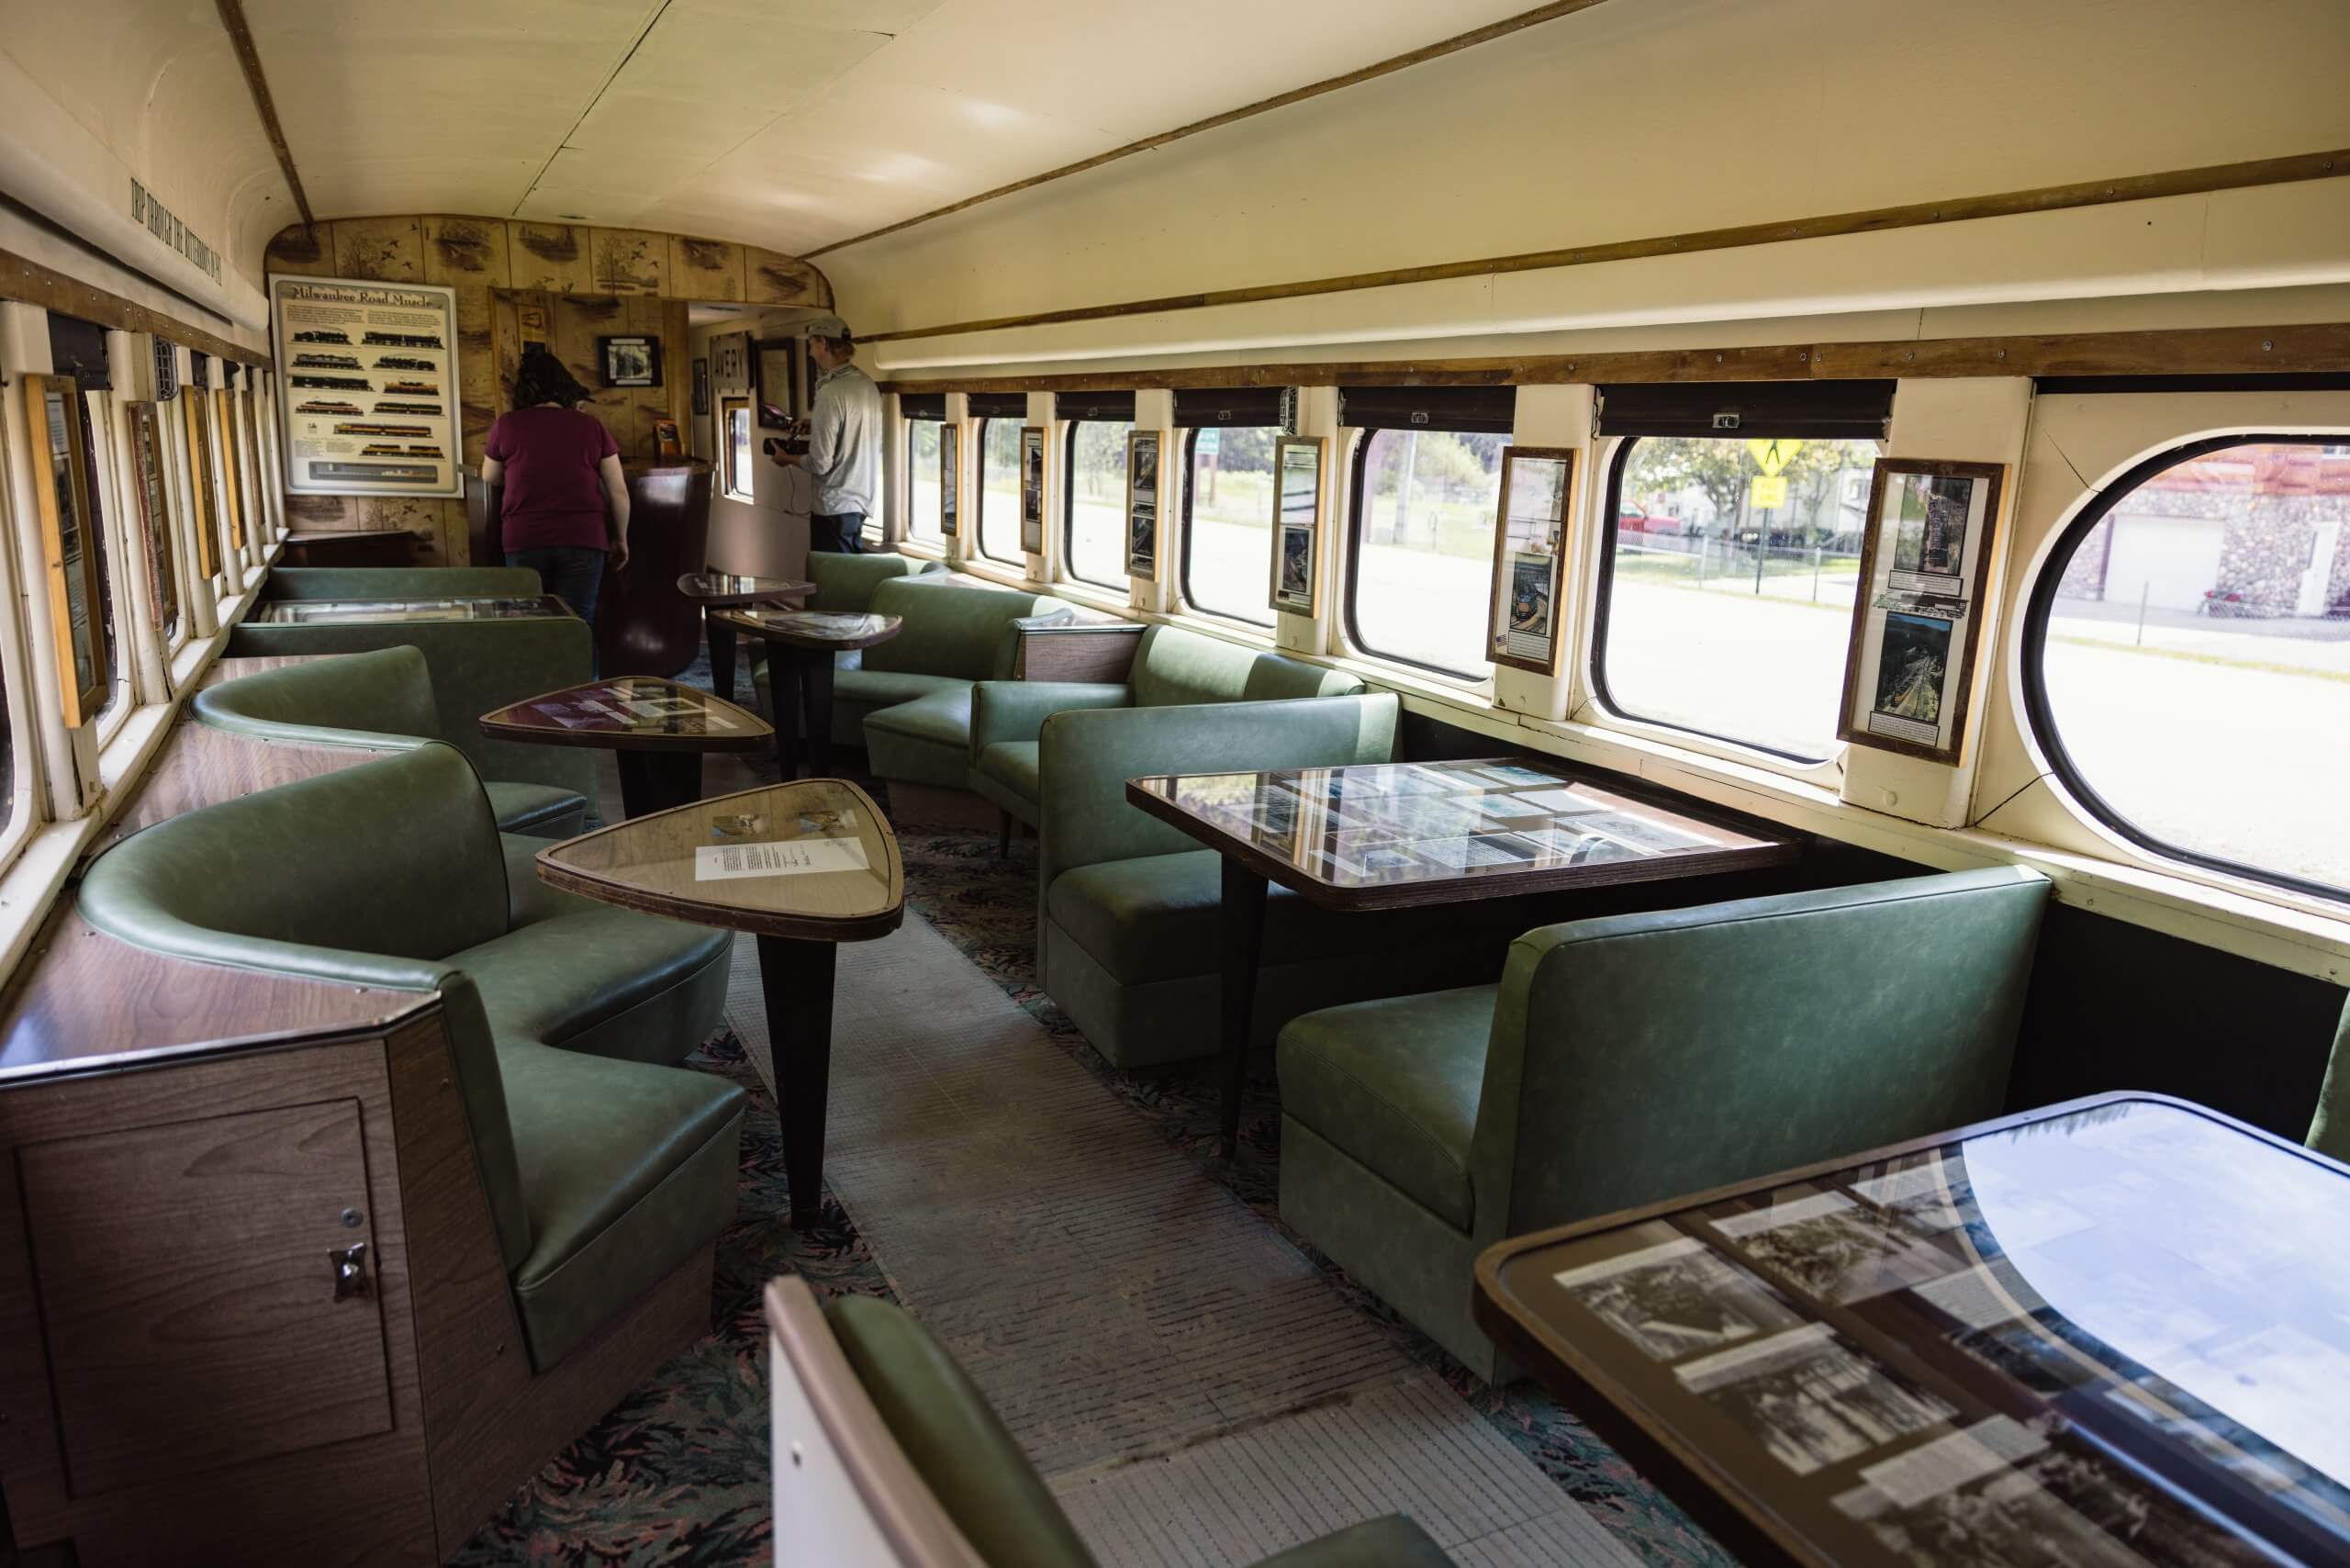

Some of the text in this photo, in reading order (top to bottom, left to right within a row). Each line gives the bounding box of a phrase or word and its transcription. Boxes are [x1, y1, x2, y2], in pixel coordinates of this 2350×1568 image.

[130, 176, 145, 225] TRIP
[147, 192, 172, 247] THROUGH
[173, 216, 183, 255] THE
[293, 286, 436, 308] Milwaukee Road Muscle
